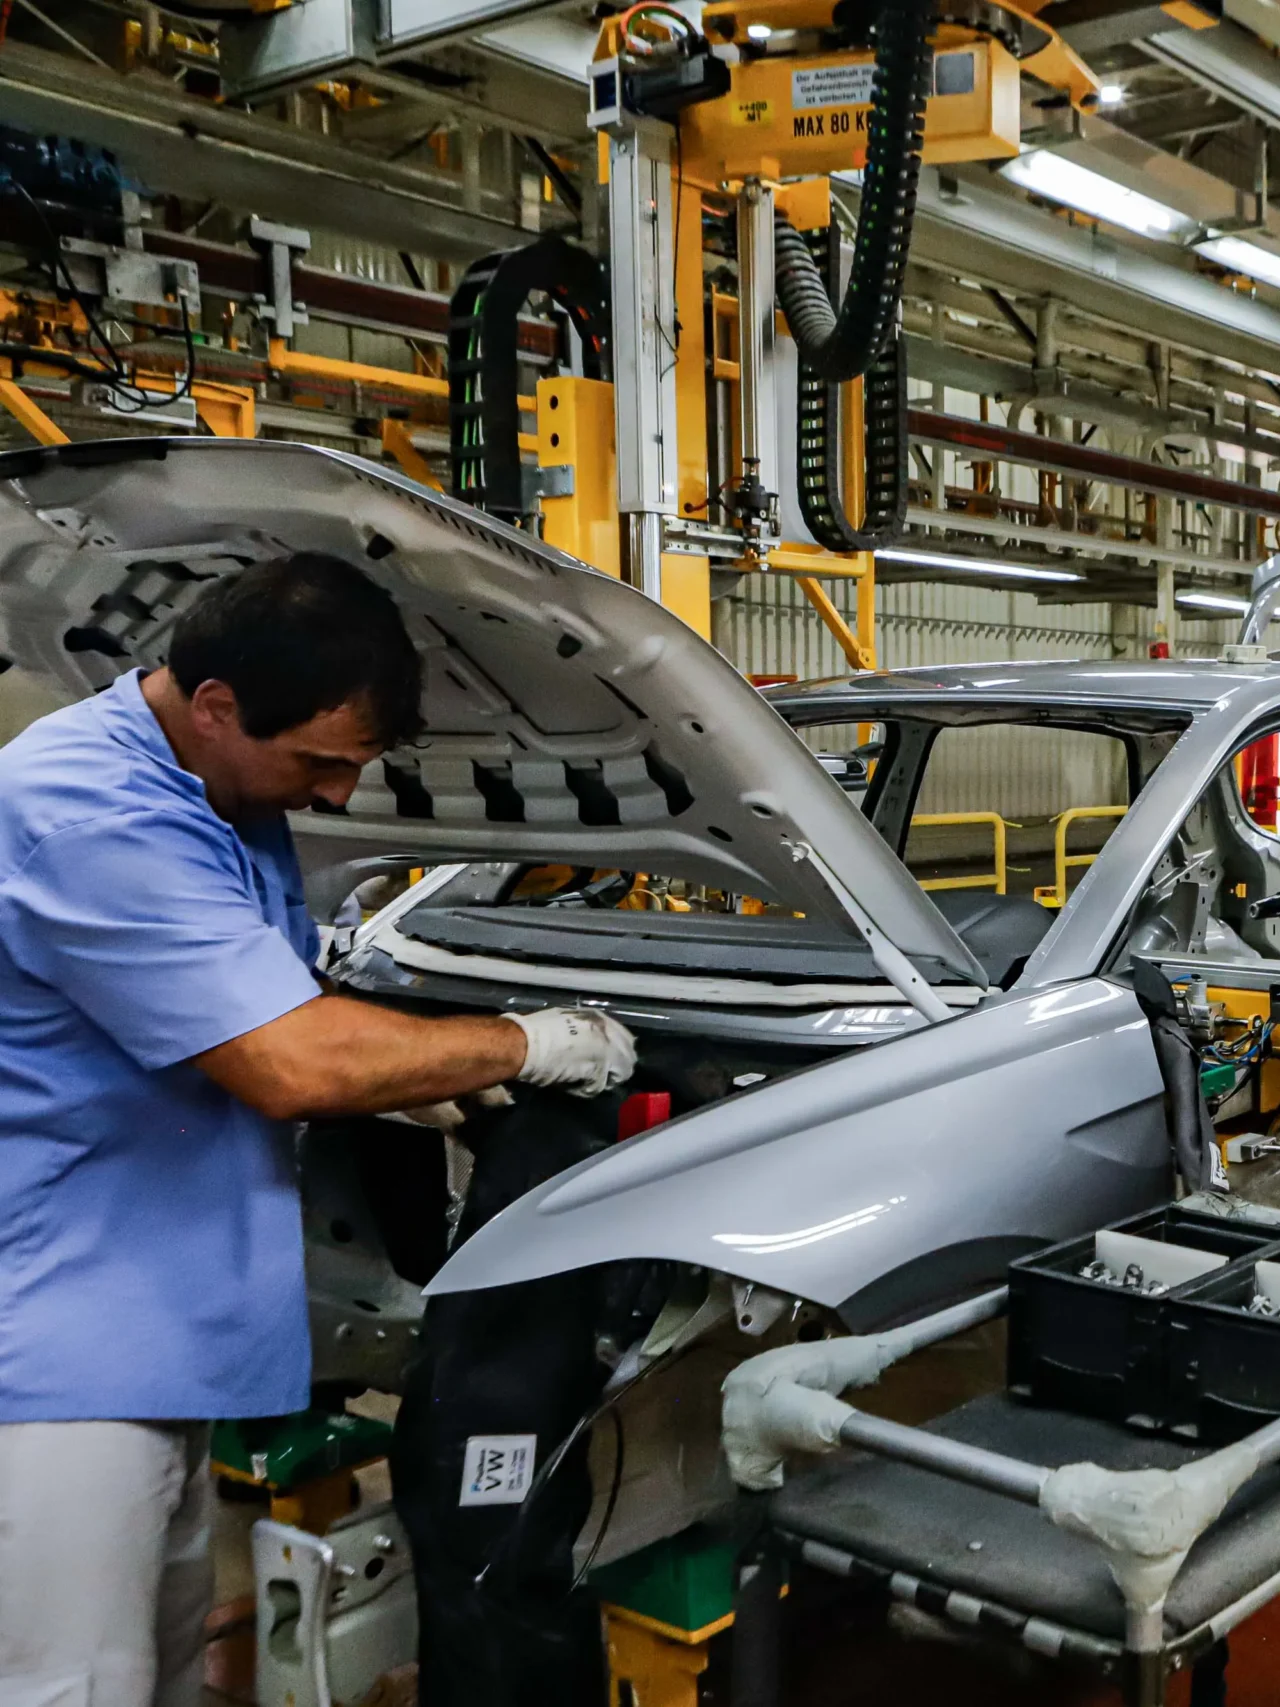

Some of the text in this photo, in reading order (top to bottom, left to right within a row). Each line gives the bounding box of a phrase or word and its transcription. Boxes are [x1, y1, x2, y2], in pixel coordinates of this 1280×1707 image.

[793, 114, 824, 138] MAX
[830, 111, 850, 135] 80
[484, 1450, 505, 1492] VW
